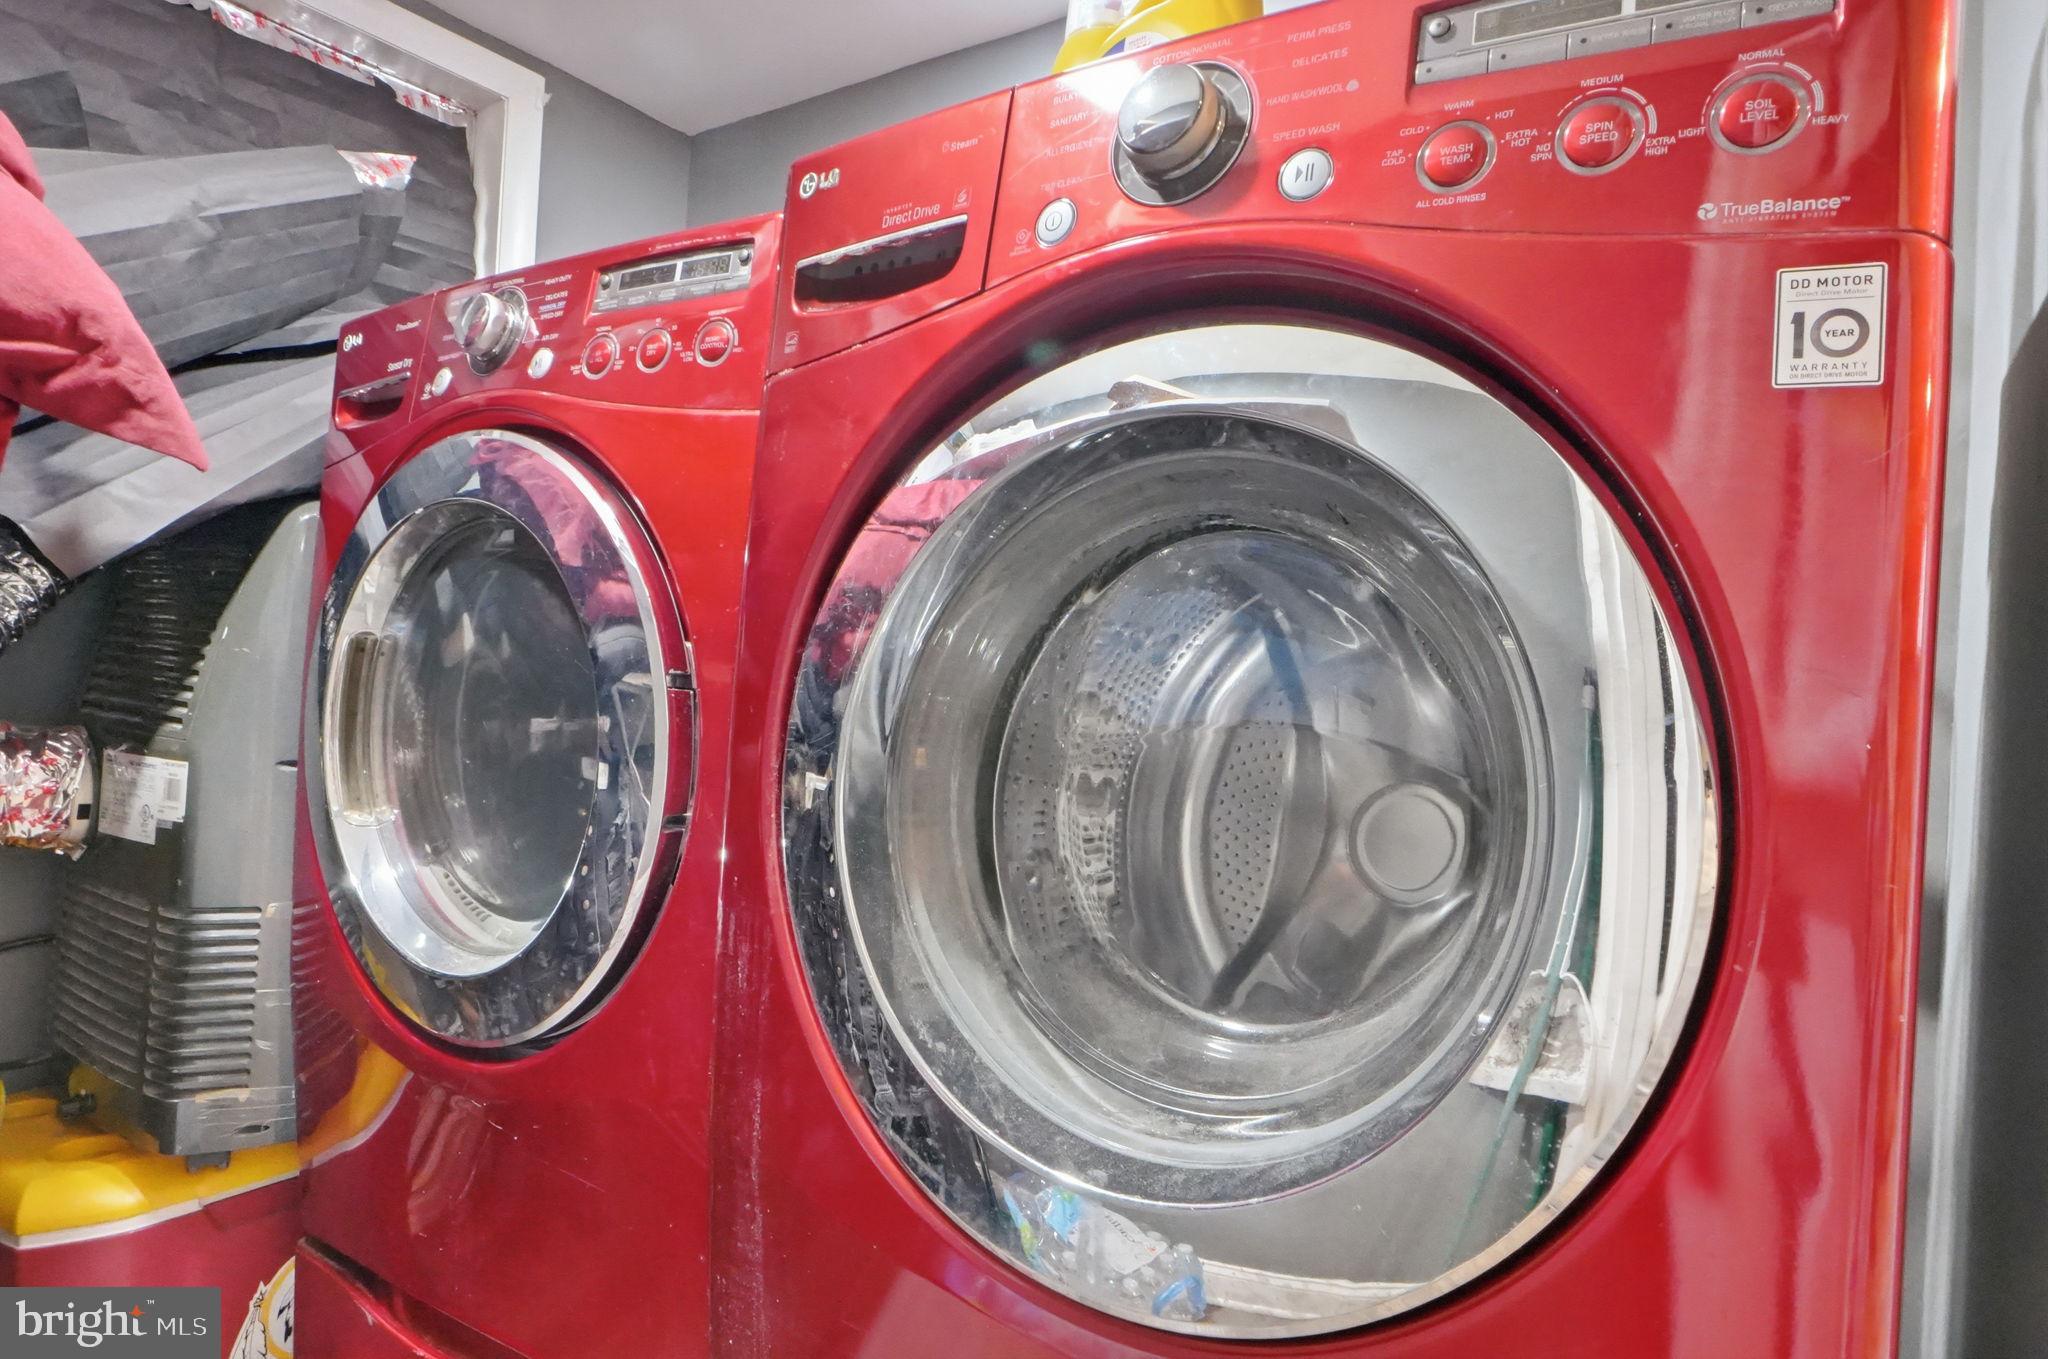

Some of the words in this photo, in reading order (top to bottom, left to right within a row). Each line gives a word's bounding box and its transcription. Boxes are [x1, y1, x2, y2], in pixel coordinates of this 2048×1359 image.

[1286, 29, 1317, 45] PERM
[1317, 20, 1352, 38] PRESS
[1291, 47, 1349, 69] DELICATES
[1738, 48, 1786, 62] NORMAL
[1580, 74, 1624, 88] MEDIUM
[1266, 93, 1290, 107] HAND
[1443, 99, 1474, 112] WARM
[1744, 98, 1776, 113] SOIL
[1049, 110, 1089, 129] SANITARY
[1494, 109, 1515, 120] HOT
[1739, 109, 1780, 123] LEVEL
[1811, 113, 1850, 126] HEAVY
[1272, 128, 1306, 143] SPEED
[1307, 121, 1342, 136] WASH
[1399, 125, 1425, 137] COLD
[1585, 120, 1614, 133] SPIN
[1678, 126, 1706, 139] LIGHT
[1505, 128, 1538, 141] EXTRA
[1578, 130, 1620, 145] SPEED
[1645, 135, 1676, 147] EXTRA
[1510, 136, 1531, 148] HOT
[1535, 143, 1551, 153] NO
[1385, 149, 1403, 159] TAP
[1439, 142, 1474, 156] WASH
[1645, 145, 1669, 156] HIGH
[1381, 155, 1406, 167] COLD
[1530, 152, 1552, 163] SPIN
[819, 167, 841, 189] LG
[1416, 199, 1431, 209] ALL
[1432, 196, 1455, 207] COLD
[1456, 192, 1487, 205] RINSES
[881, 208, 912, 229] Direct
[912, 202, 941, 222] Drive
[1790, 279, 1811, 290] DD
[1816, 274, 1874, 288] MOTOR
[1820, 289, 1842, 297] Drive
[1843, 288, 1869, 296] Motor
[1790, 307, 1870, 359] 10
[1825, 328, 1855, 338] YEAR
[699, 341, 726, 350] CONTROL
[1789, 361, 1868, 373] WARRANTY
[1789, 372, 1799, 380] ON
[1823, 371, 1842, 379] DRIVE
[1844, 370, 1868, 378] MOTOR
